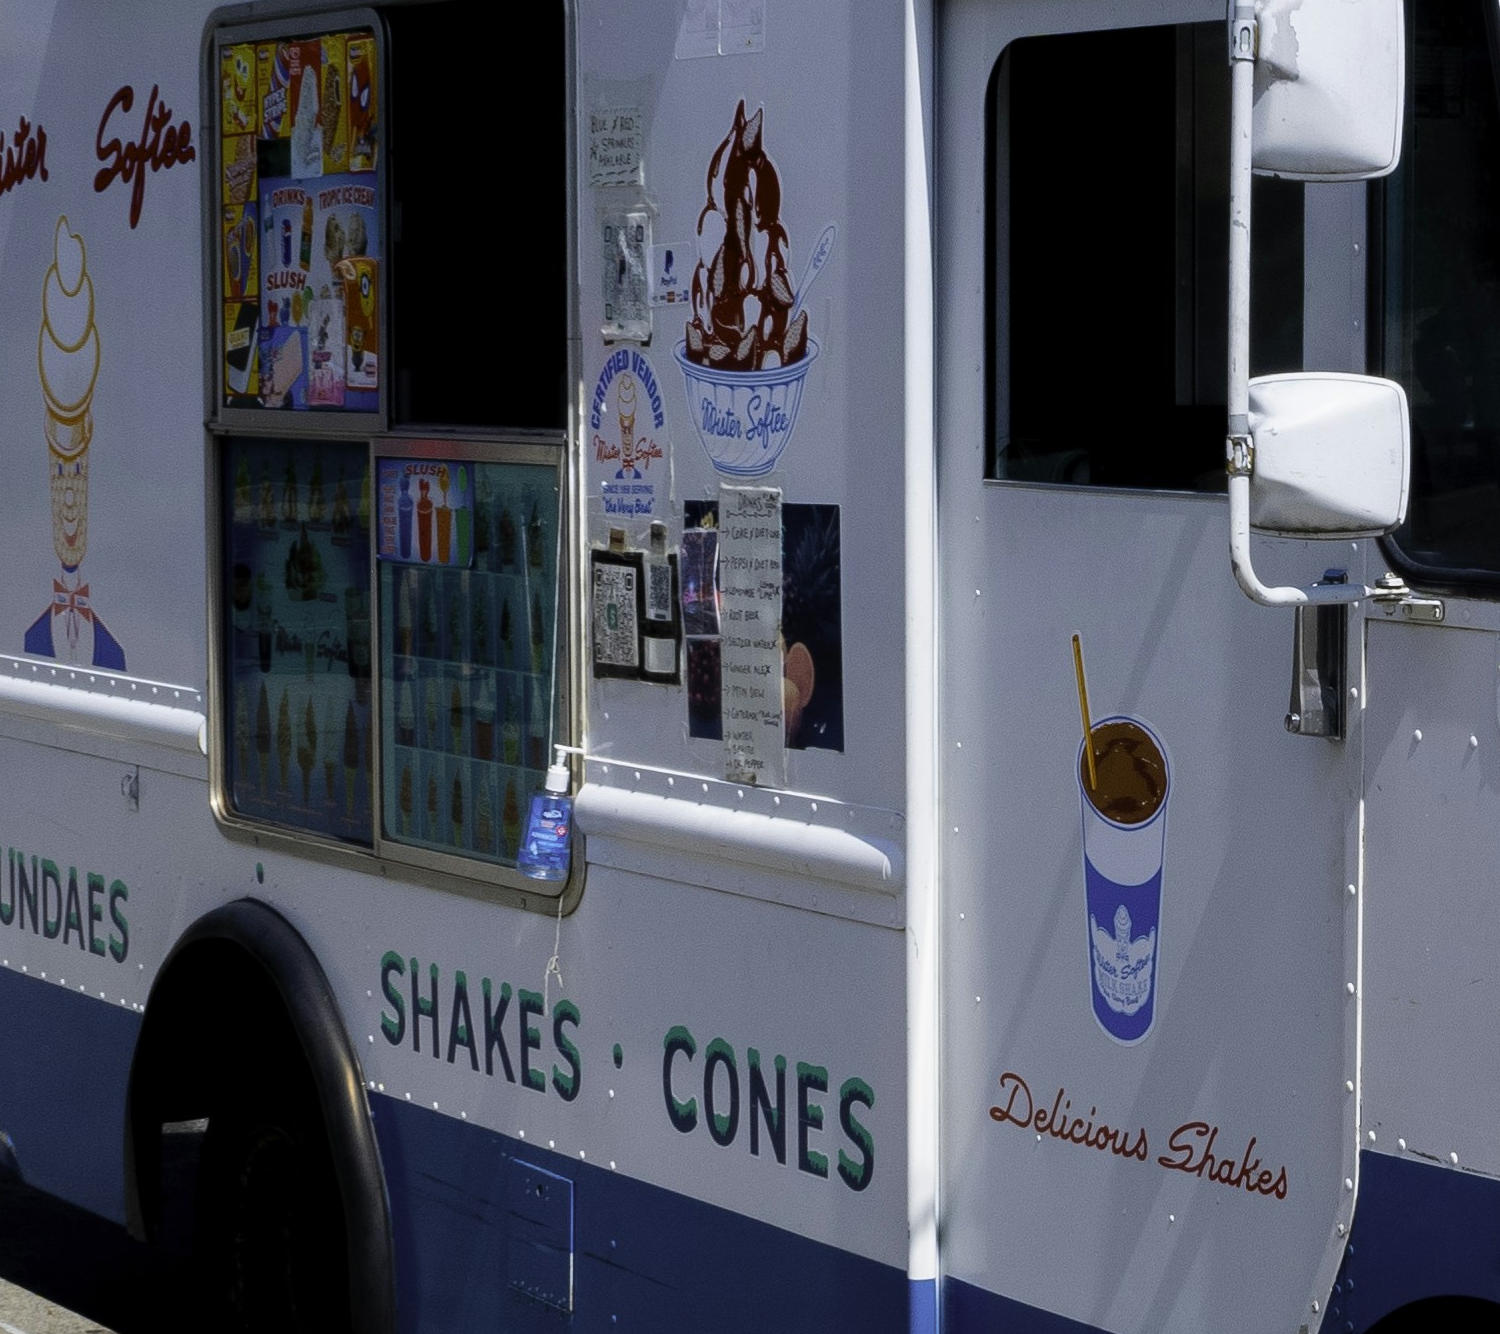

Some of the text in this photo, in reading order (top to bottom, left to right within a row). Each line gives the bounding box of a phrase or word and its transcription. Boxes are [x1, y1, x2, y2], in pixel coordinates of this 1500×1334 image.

[94, 84, 196, 229] Softee
[272, 188, 306, 208] DRINKS
[266, 271, 307, 291] SLUSH
[591, 349, 664, 429] CERTIFIED VENDOR
[701, 395, 790, 449] Mister Softee
[378, 949, 876, 1193] SHAKES CONES
[989, 1072, 1288, 1201] Delicious Shakes
